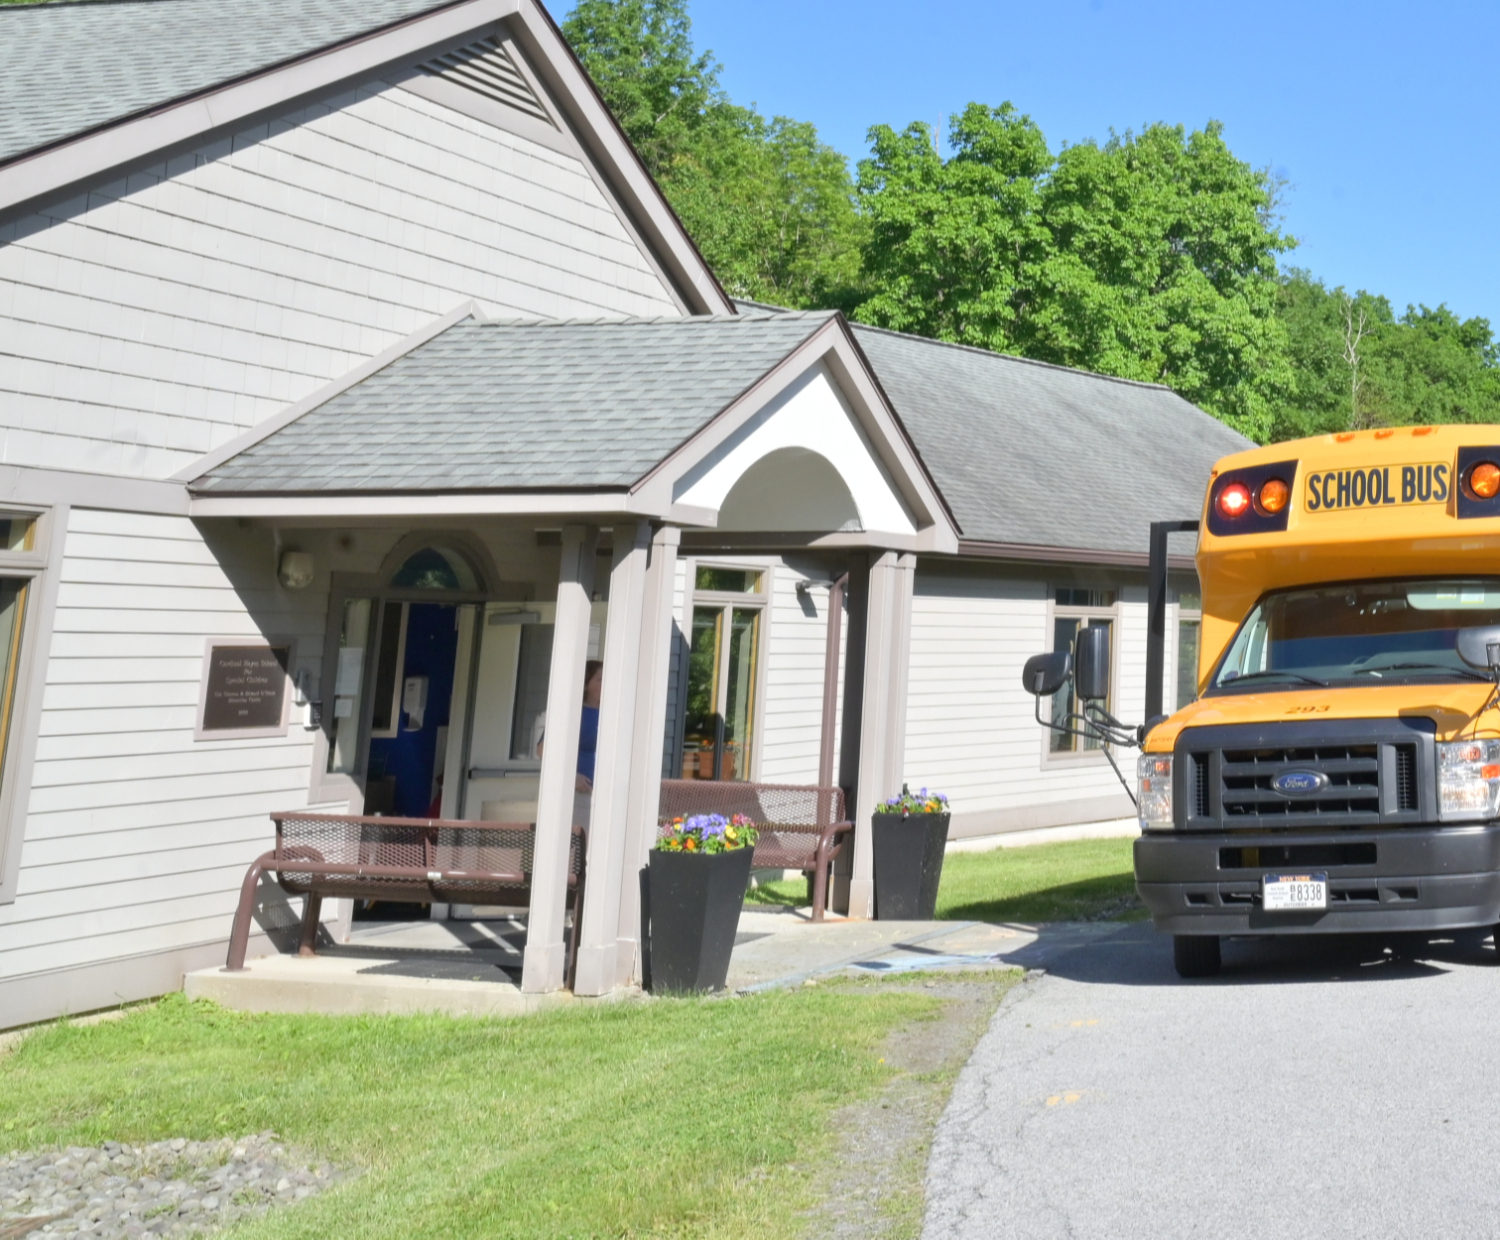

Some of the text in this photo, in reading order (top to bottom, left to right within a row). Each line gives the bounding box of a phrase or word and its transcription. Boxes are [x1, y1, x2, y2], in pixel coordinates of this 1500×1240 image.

[1308, 464, 1448, 511] SCHOOL BUS
[1284, 705, 1331, 715] 293
[1284, 776, 1308, 789] Ford
[1297, 883, 1323, 901] 8338
